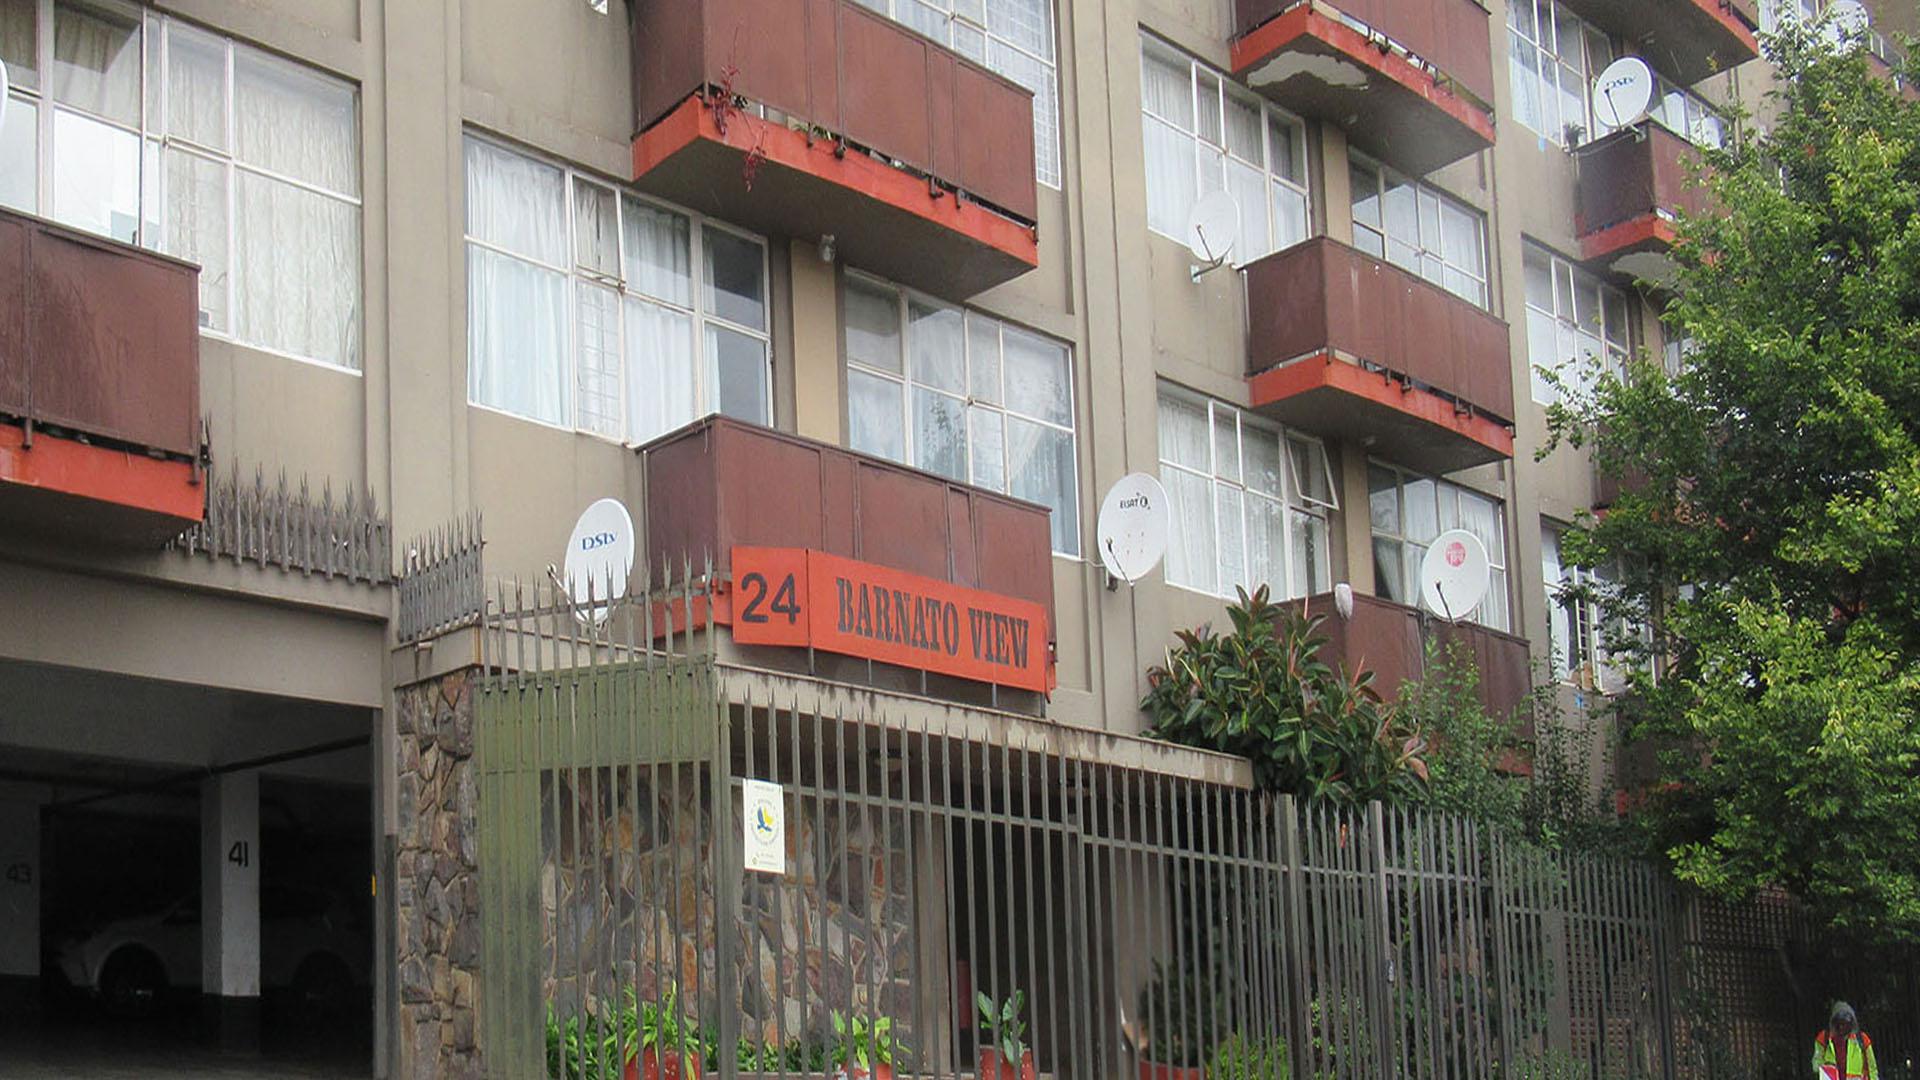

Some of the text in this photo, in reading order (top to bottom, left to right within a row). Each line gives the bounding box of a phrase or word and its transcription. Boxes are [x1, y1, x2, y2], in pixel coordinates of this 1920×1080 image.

[741, 572, 800, 625] 24
[836, 577, 1029, 669] BARNATO VIEW
[228, 841, 249, 867] 41
